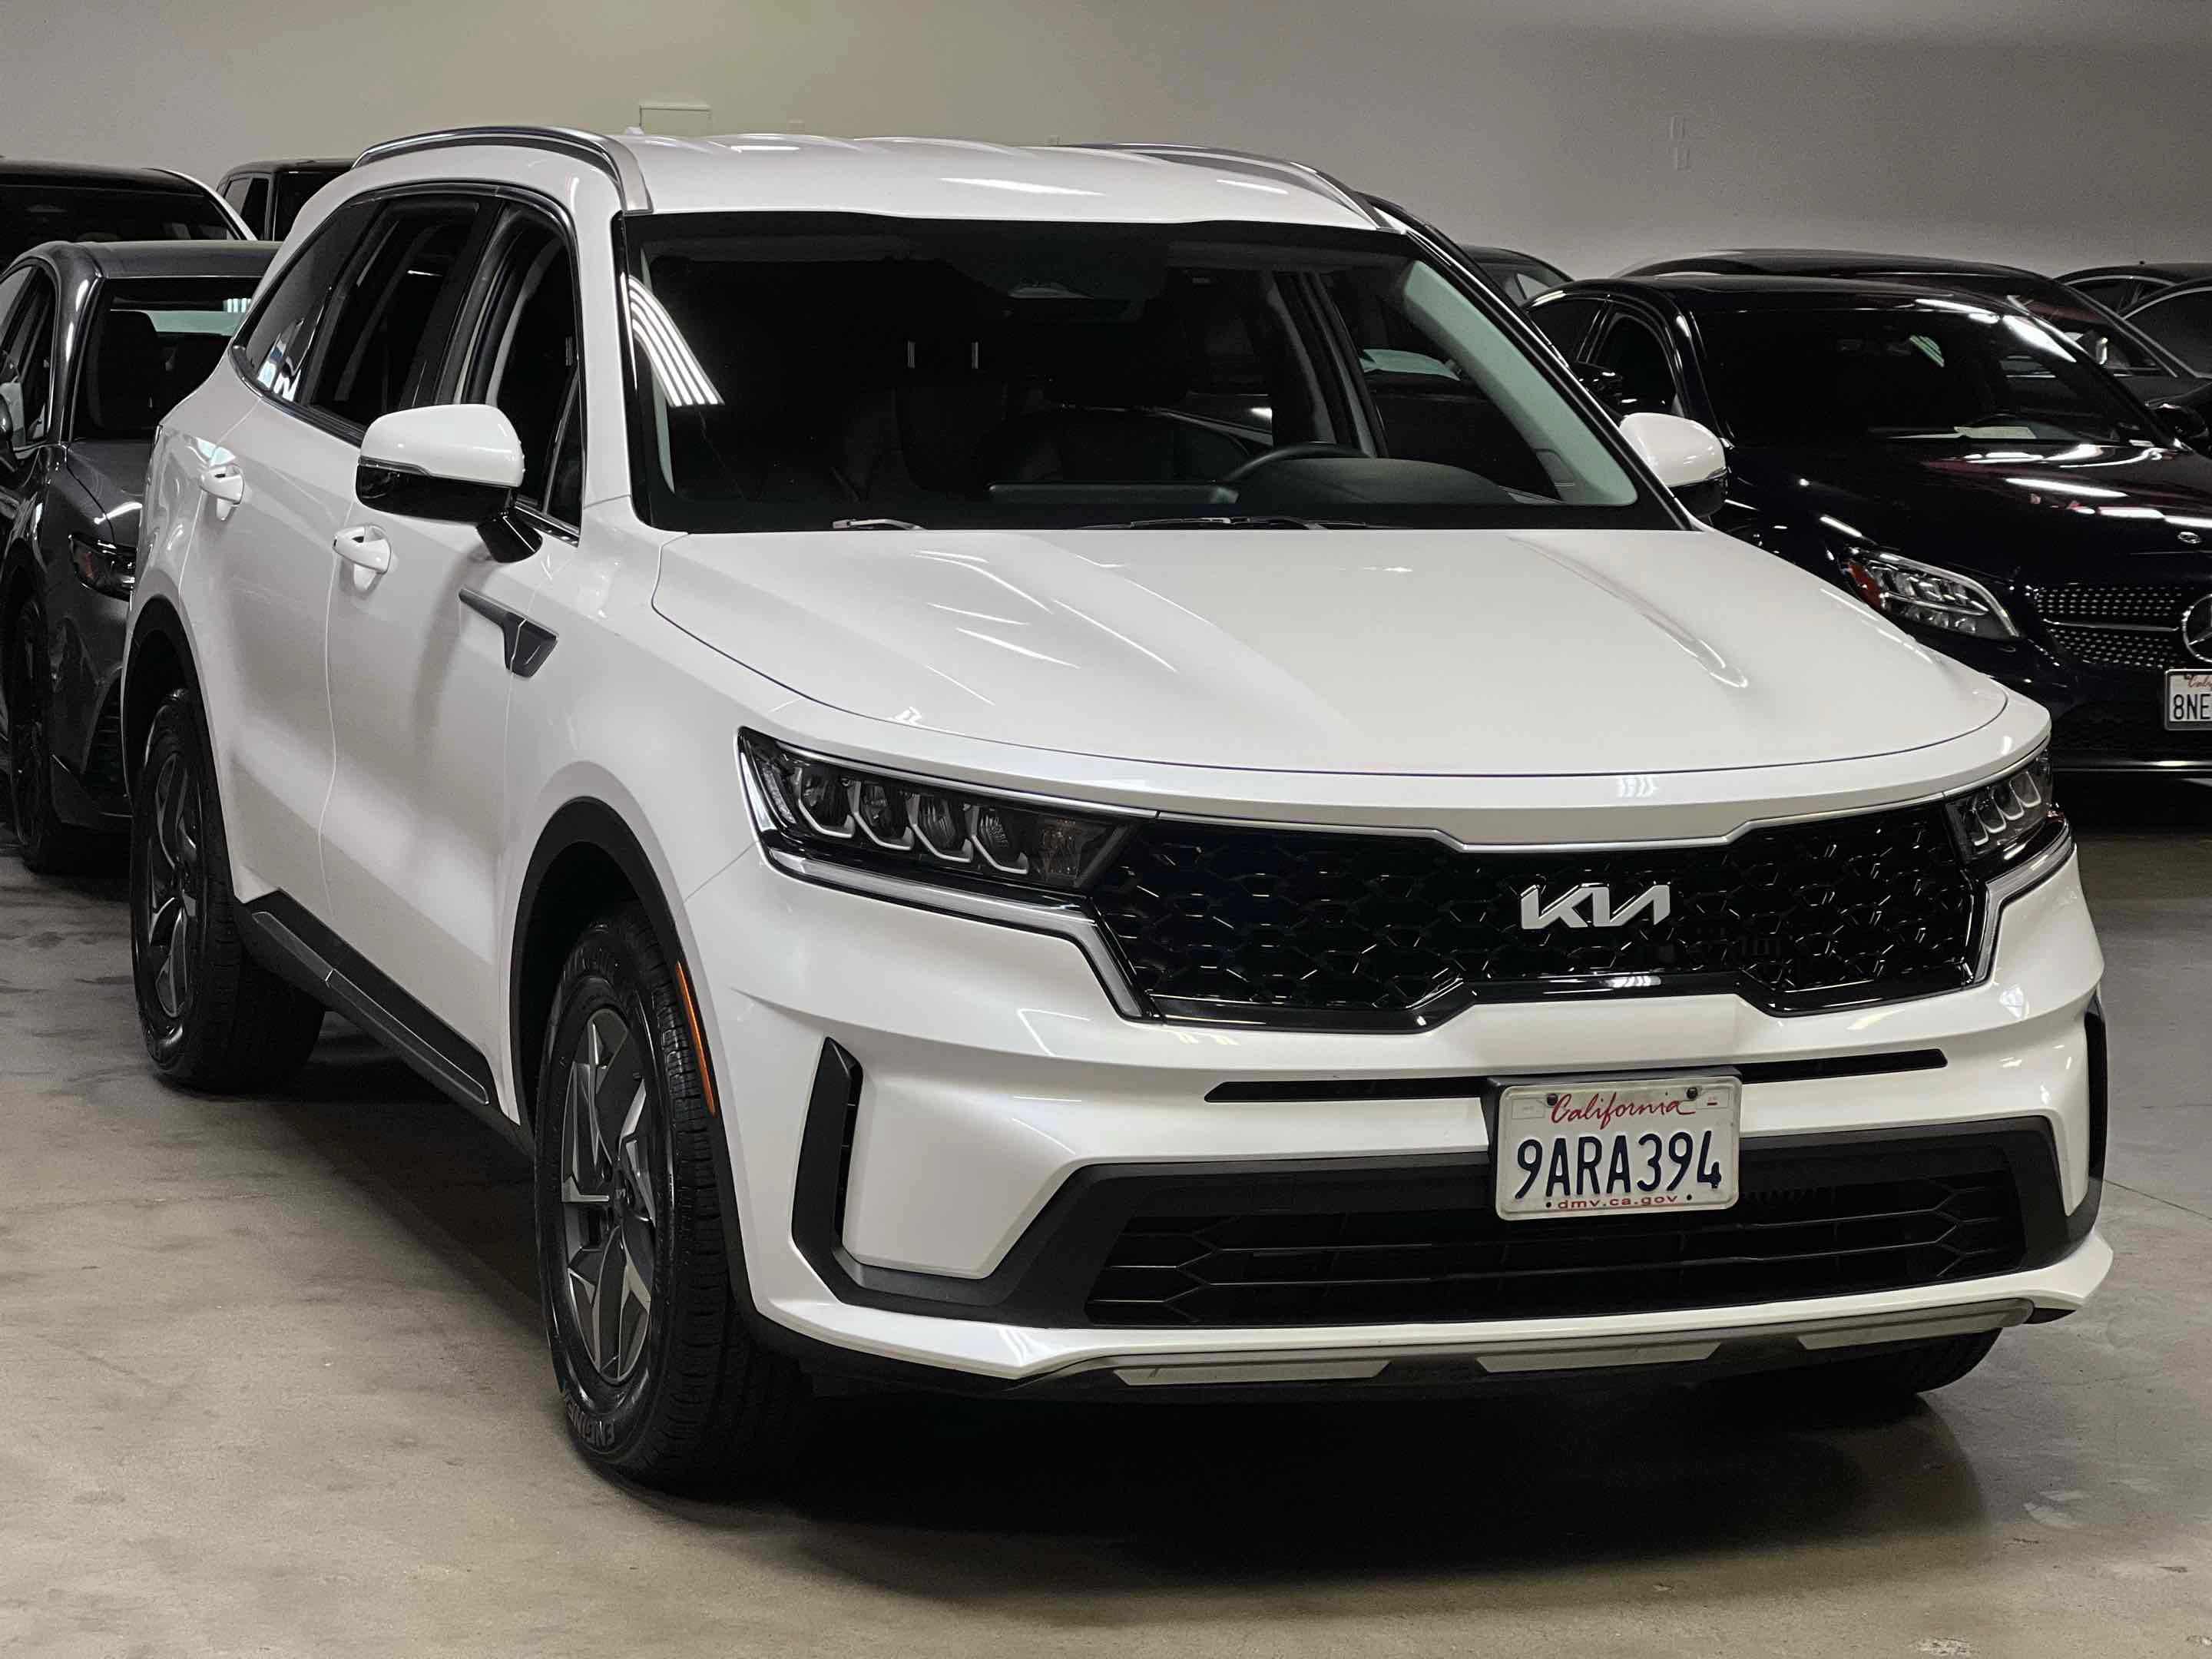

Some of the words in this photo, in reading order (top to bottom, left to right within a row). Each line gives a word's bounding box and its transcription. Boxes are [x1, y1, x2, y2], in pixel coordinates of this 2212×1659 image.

[1520, 883, 1671, 930] KIA
[1551, 1091, 1696, 1130] California
[1514, 1130, 1723, 1200] 9ARA394
[1557, 1194, 1679, 1210] dmv.ca.gov
